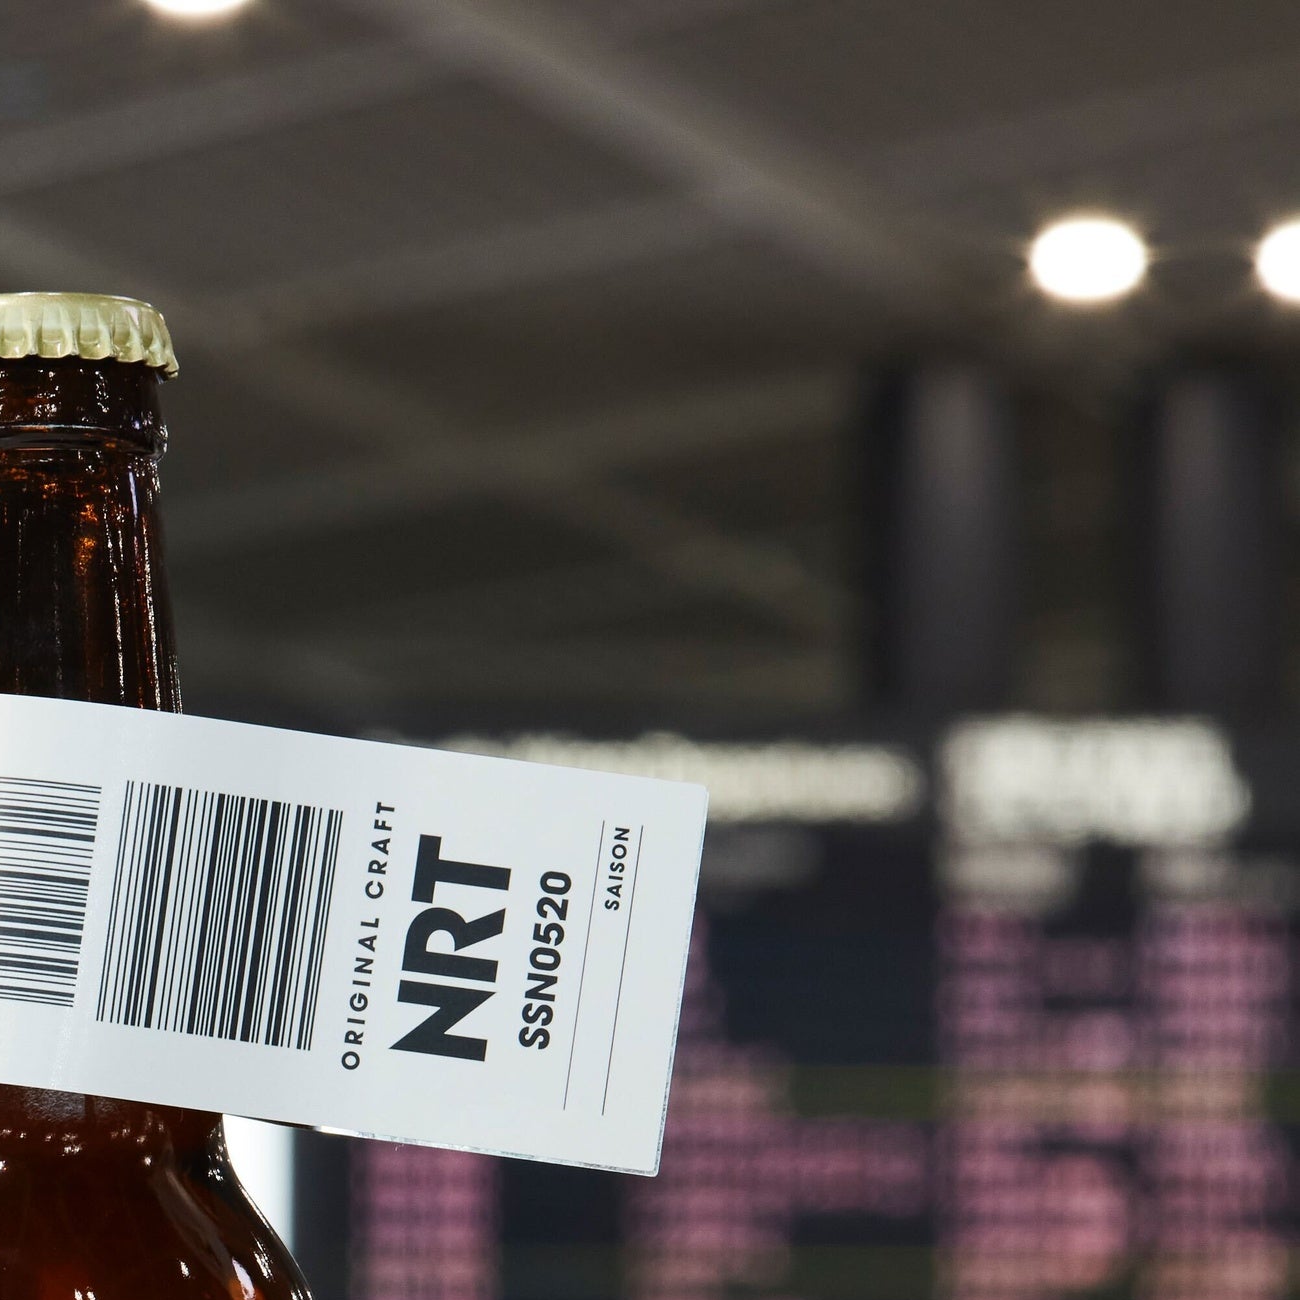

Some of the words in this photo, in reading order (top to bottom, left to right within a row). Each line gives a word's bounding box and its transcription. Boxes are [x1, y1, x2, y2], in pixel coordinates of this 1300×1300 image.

[341, 917, 379, 1070] ORIGINAL
[365, 801, 396, 899] CRAFT
[388, 833, 512, 1062] NRT
[518, 870, 572, 1050] SSN0520
[604, 826, 631, 911] SAISON
